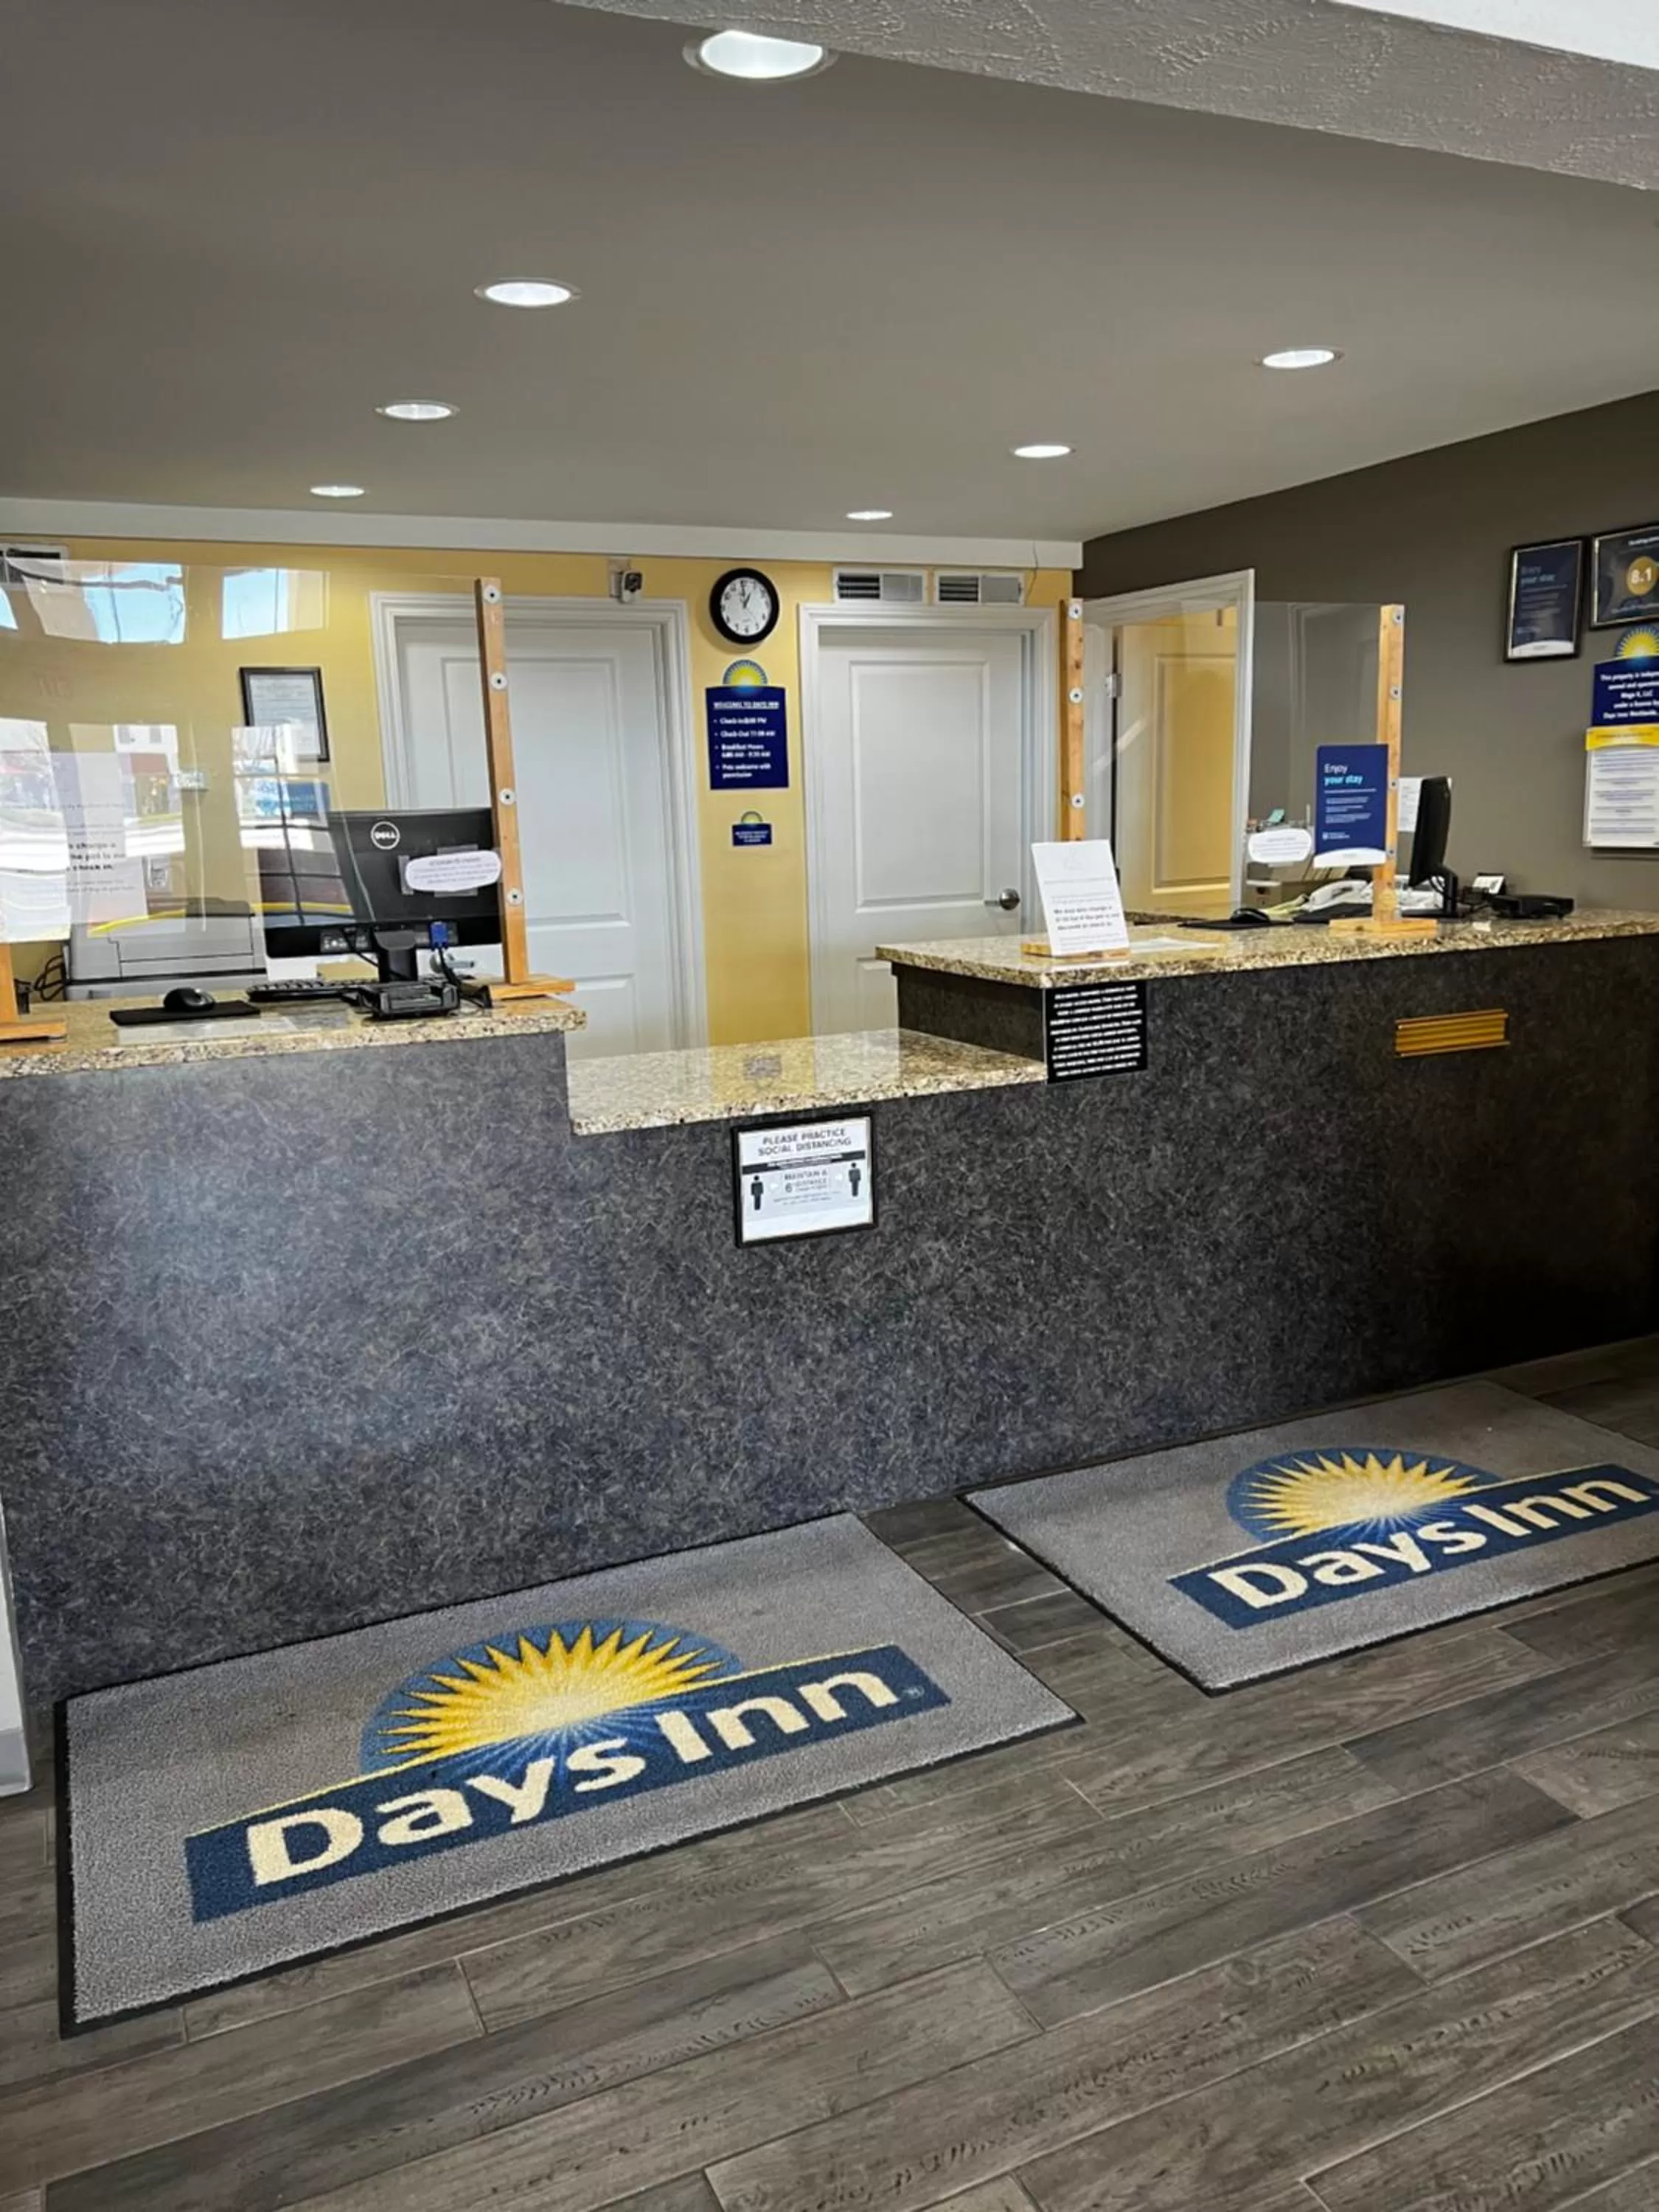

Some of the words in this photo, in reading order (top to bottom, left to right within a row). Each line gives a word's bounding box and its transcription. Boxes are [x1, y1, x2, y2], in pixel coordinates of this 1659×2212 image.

[1630, 566, 1652, 584] 8.1
[1324, 763, 1348, 775] Enjoy
[1324, 776, 1343, 787] your
[1345, 775, 1363, 785] stay
[375, 831, 396, 840] DELL
[762, 1132, 798, 1145] PLEASE
[801, 1127, 845, 1141] PRACTICE
[757, 1144, 792, 1157] SOCIAL
[796, 1136, 852, 1152] DISTANCING
[1208, 1521, 1487, 1609] Days
[1461, 1478, 1651, 1538] Inn
[247, 1738, 645, 1885] Days
[655, 1669, 899, 1763] Inn
